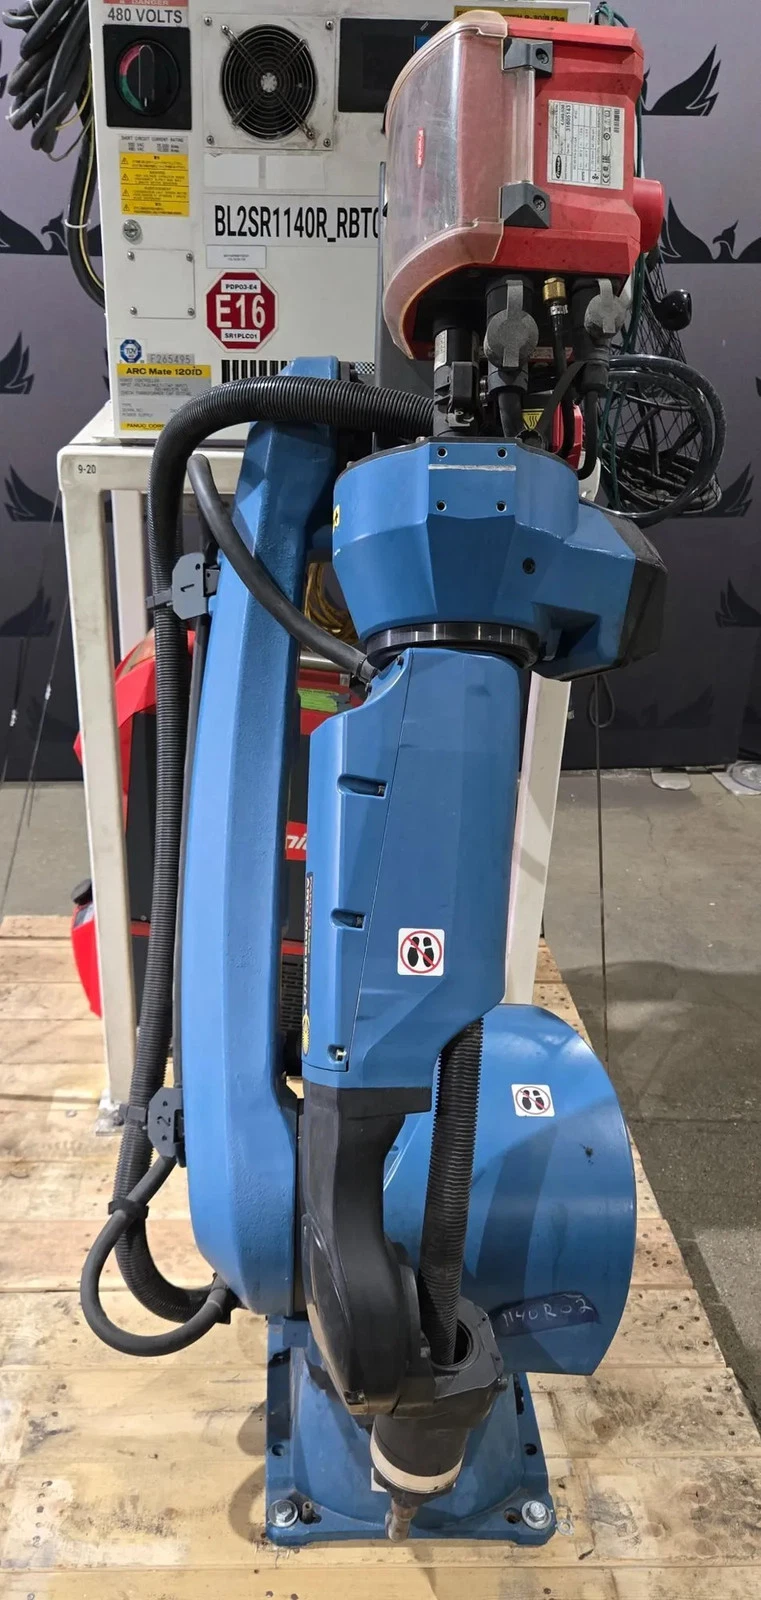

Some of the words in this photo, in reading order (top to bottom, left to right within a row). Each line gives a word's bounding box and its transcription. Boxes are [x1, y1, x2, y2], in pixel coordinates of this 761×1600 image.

[107, 7, 131, 22] 480
[136, 8, 183, 24] VOLTS
[225, 283, 258, 292] PDP03-E4
[215, 293, 266, 329] E16
[224, 331, 258, 341] SR1PLC01
[126, 367, 147, 376] ARC
[149, 368, 172, 376] Mate
[126, 422, 147, 430] FANUC
[77, 464, 97, 474] 9-20
[156, 1115, 172, 1127] 2
